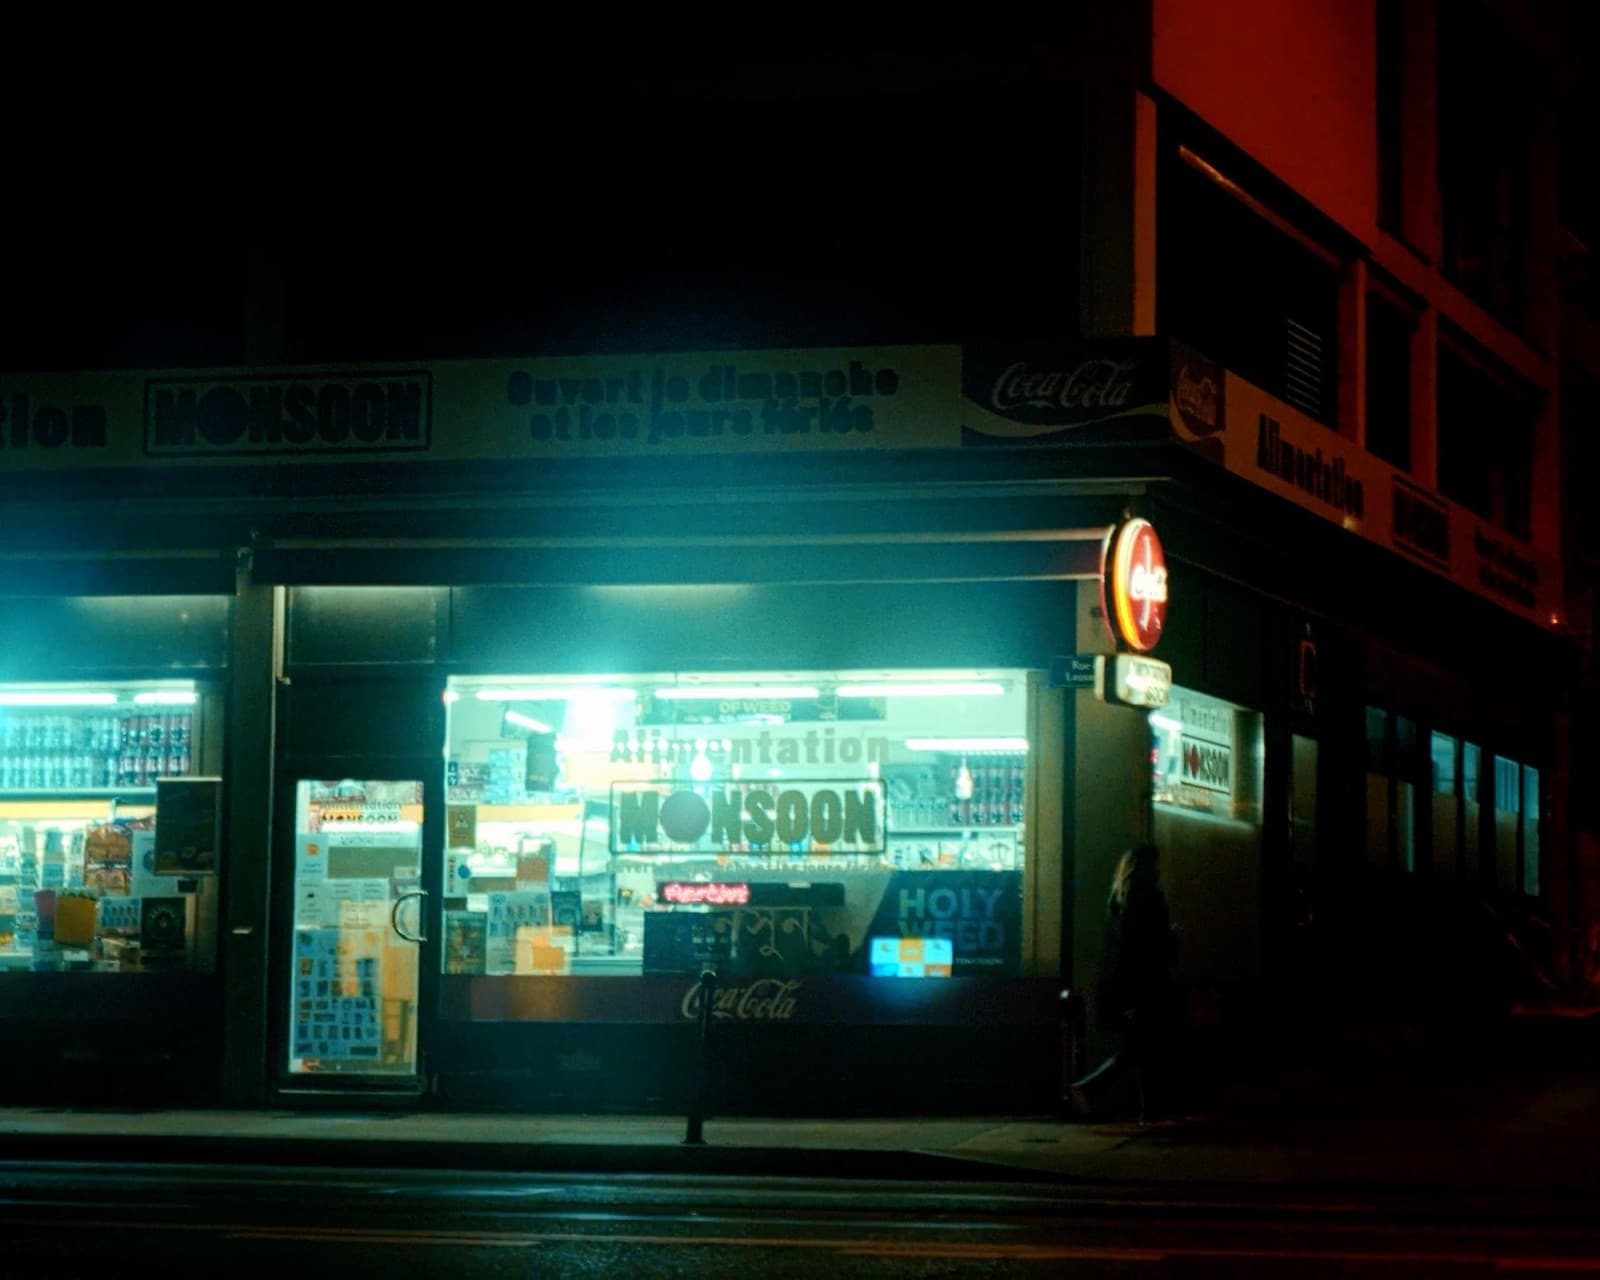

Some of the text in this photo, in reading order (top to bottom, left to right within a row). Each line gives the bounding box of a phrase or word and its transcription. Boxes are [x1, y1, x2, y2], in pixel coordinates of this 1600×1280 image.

[991, 359, 1138, 409] Coca-Cola
[153, 381, 422, 447] MONSOON
[1072, 659, 1090, 671] Rue
[619, 789, 876, 844] MONSOON
[900, 887, 1003, 919] HOLY
